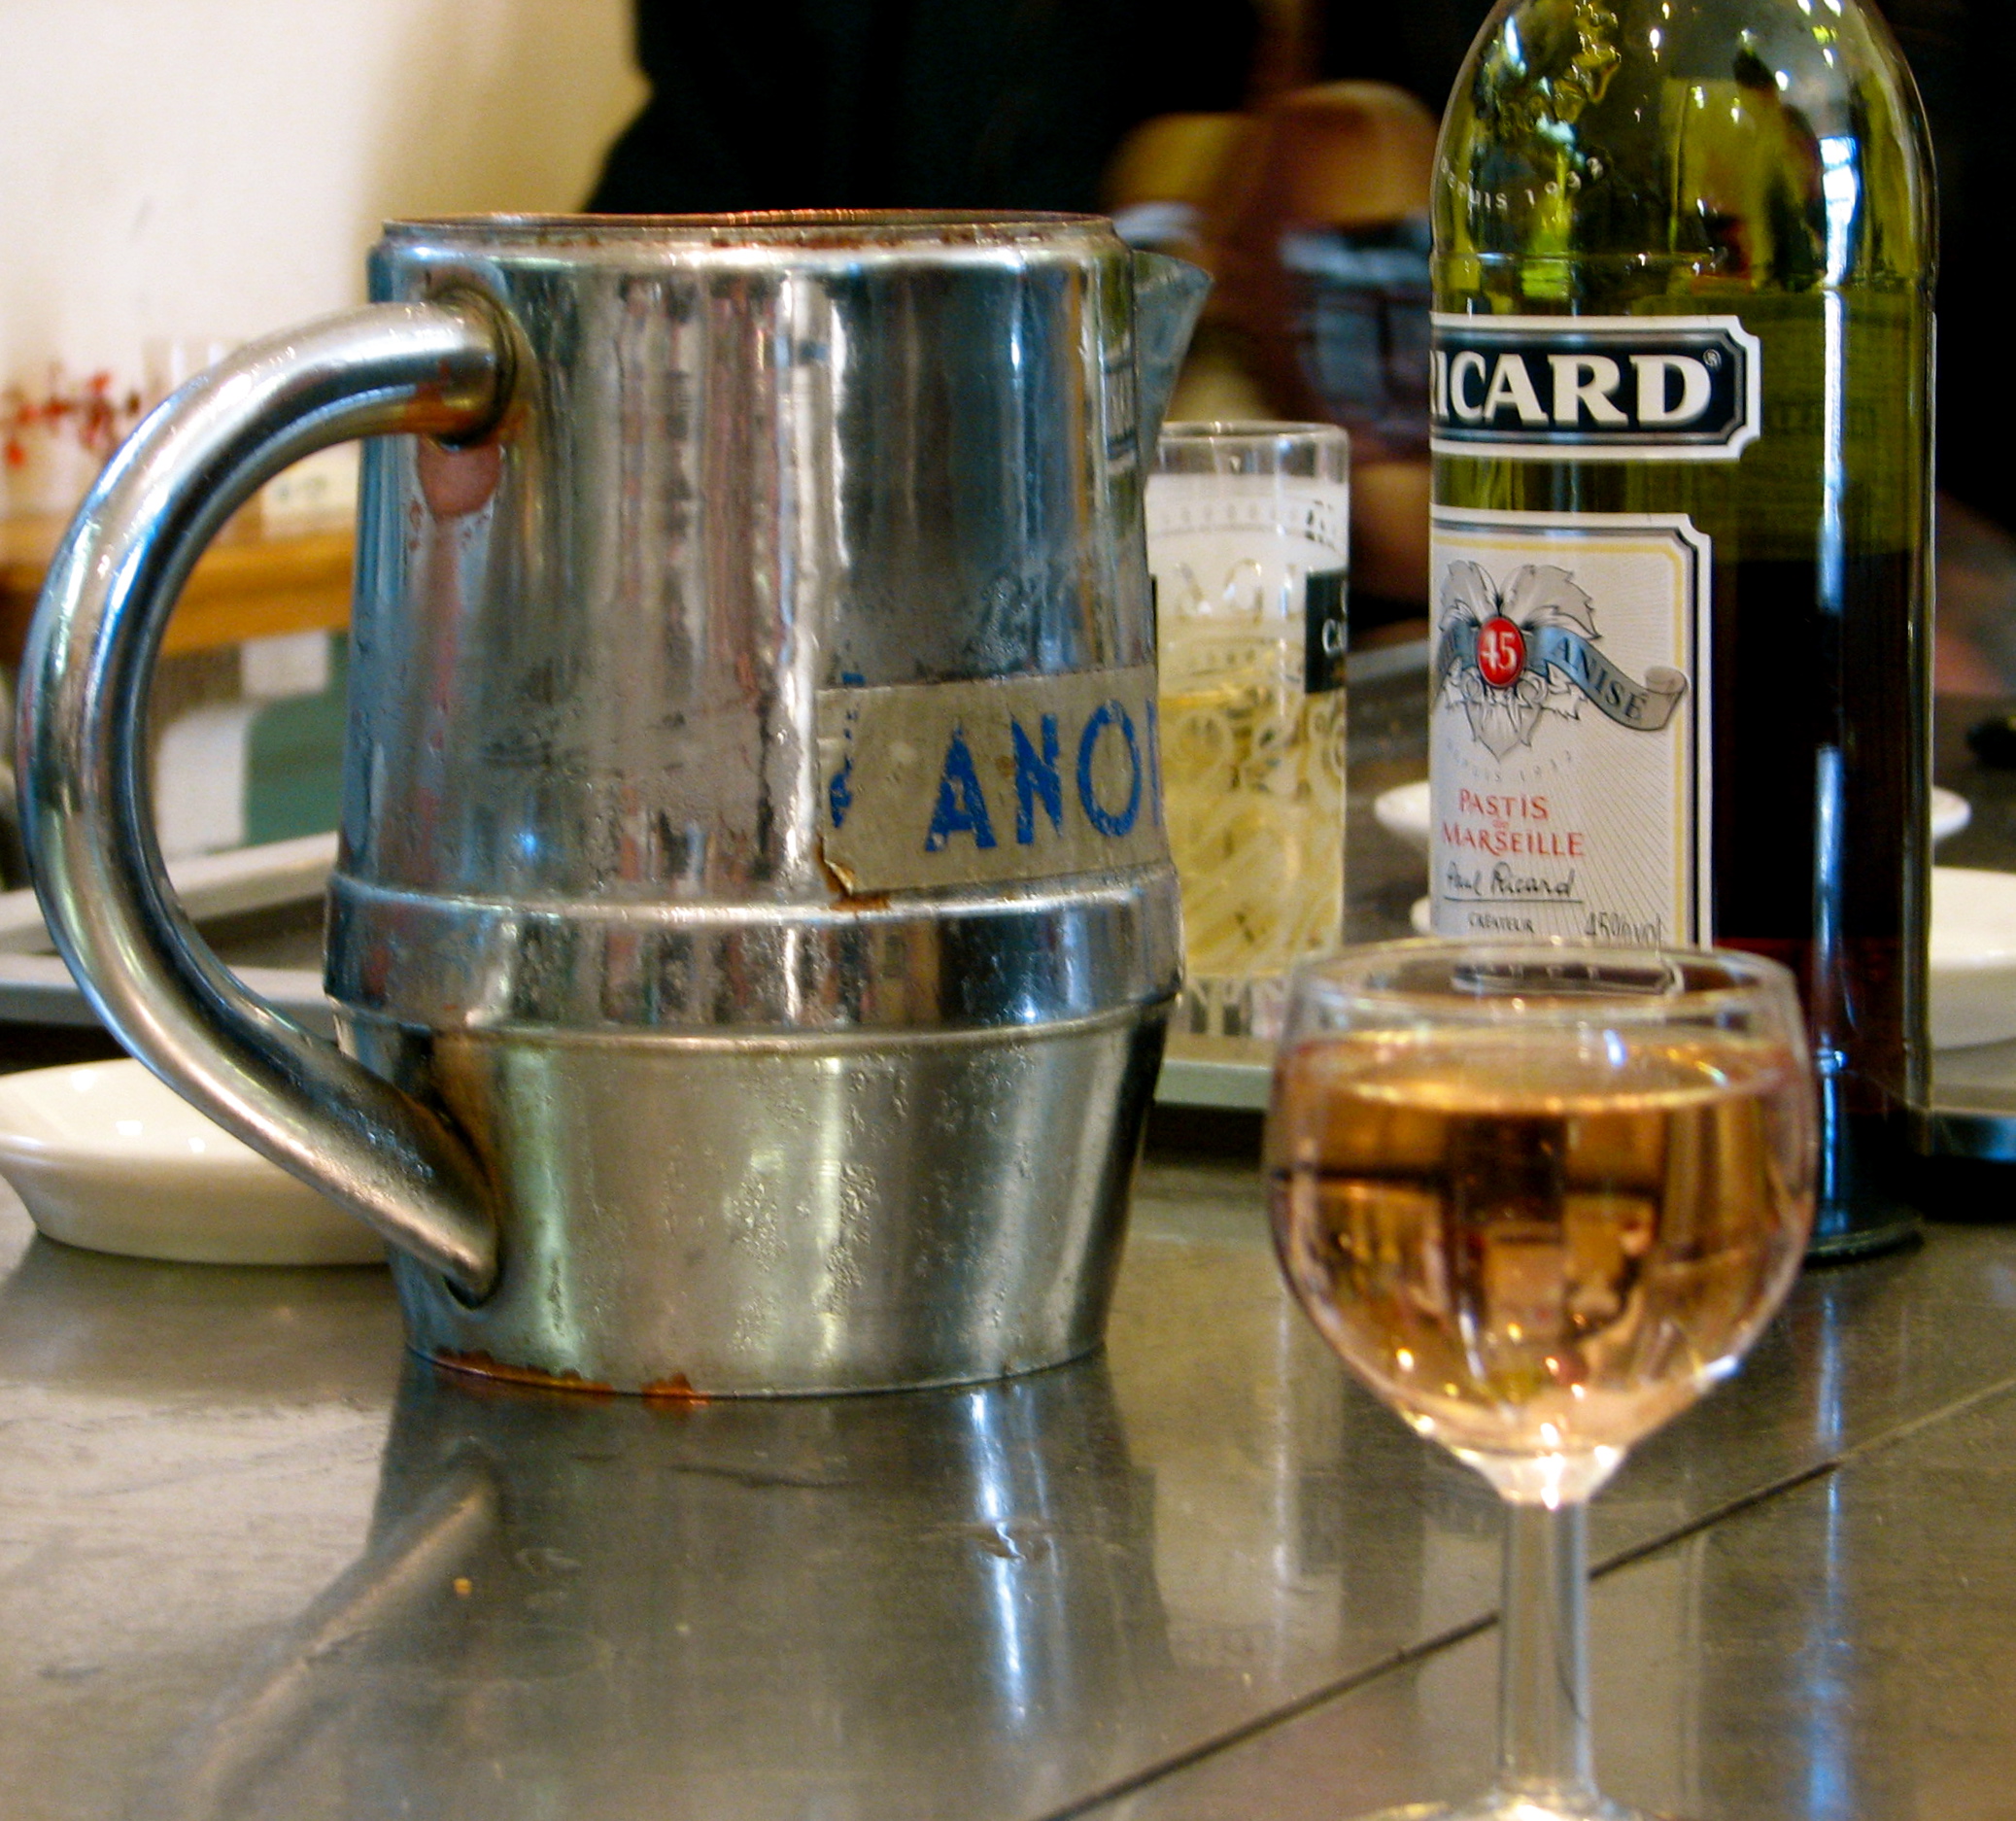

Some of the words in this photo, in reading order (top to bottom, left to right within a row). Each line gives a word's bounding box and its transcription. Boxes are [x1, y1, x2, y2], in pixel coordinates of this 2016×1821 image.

[1476, 632, 1518, 670] 45
[1459, 788, 1549, 820] PASTIS
[1442, 822, 1586, 857] MARSEILLE
[1490, 861, 1576, 897] Ricard
